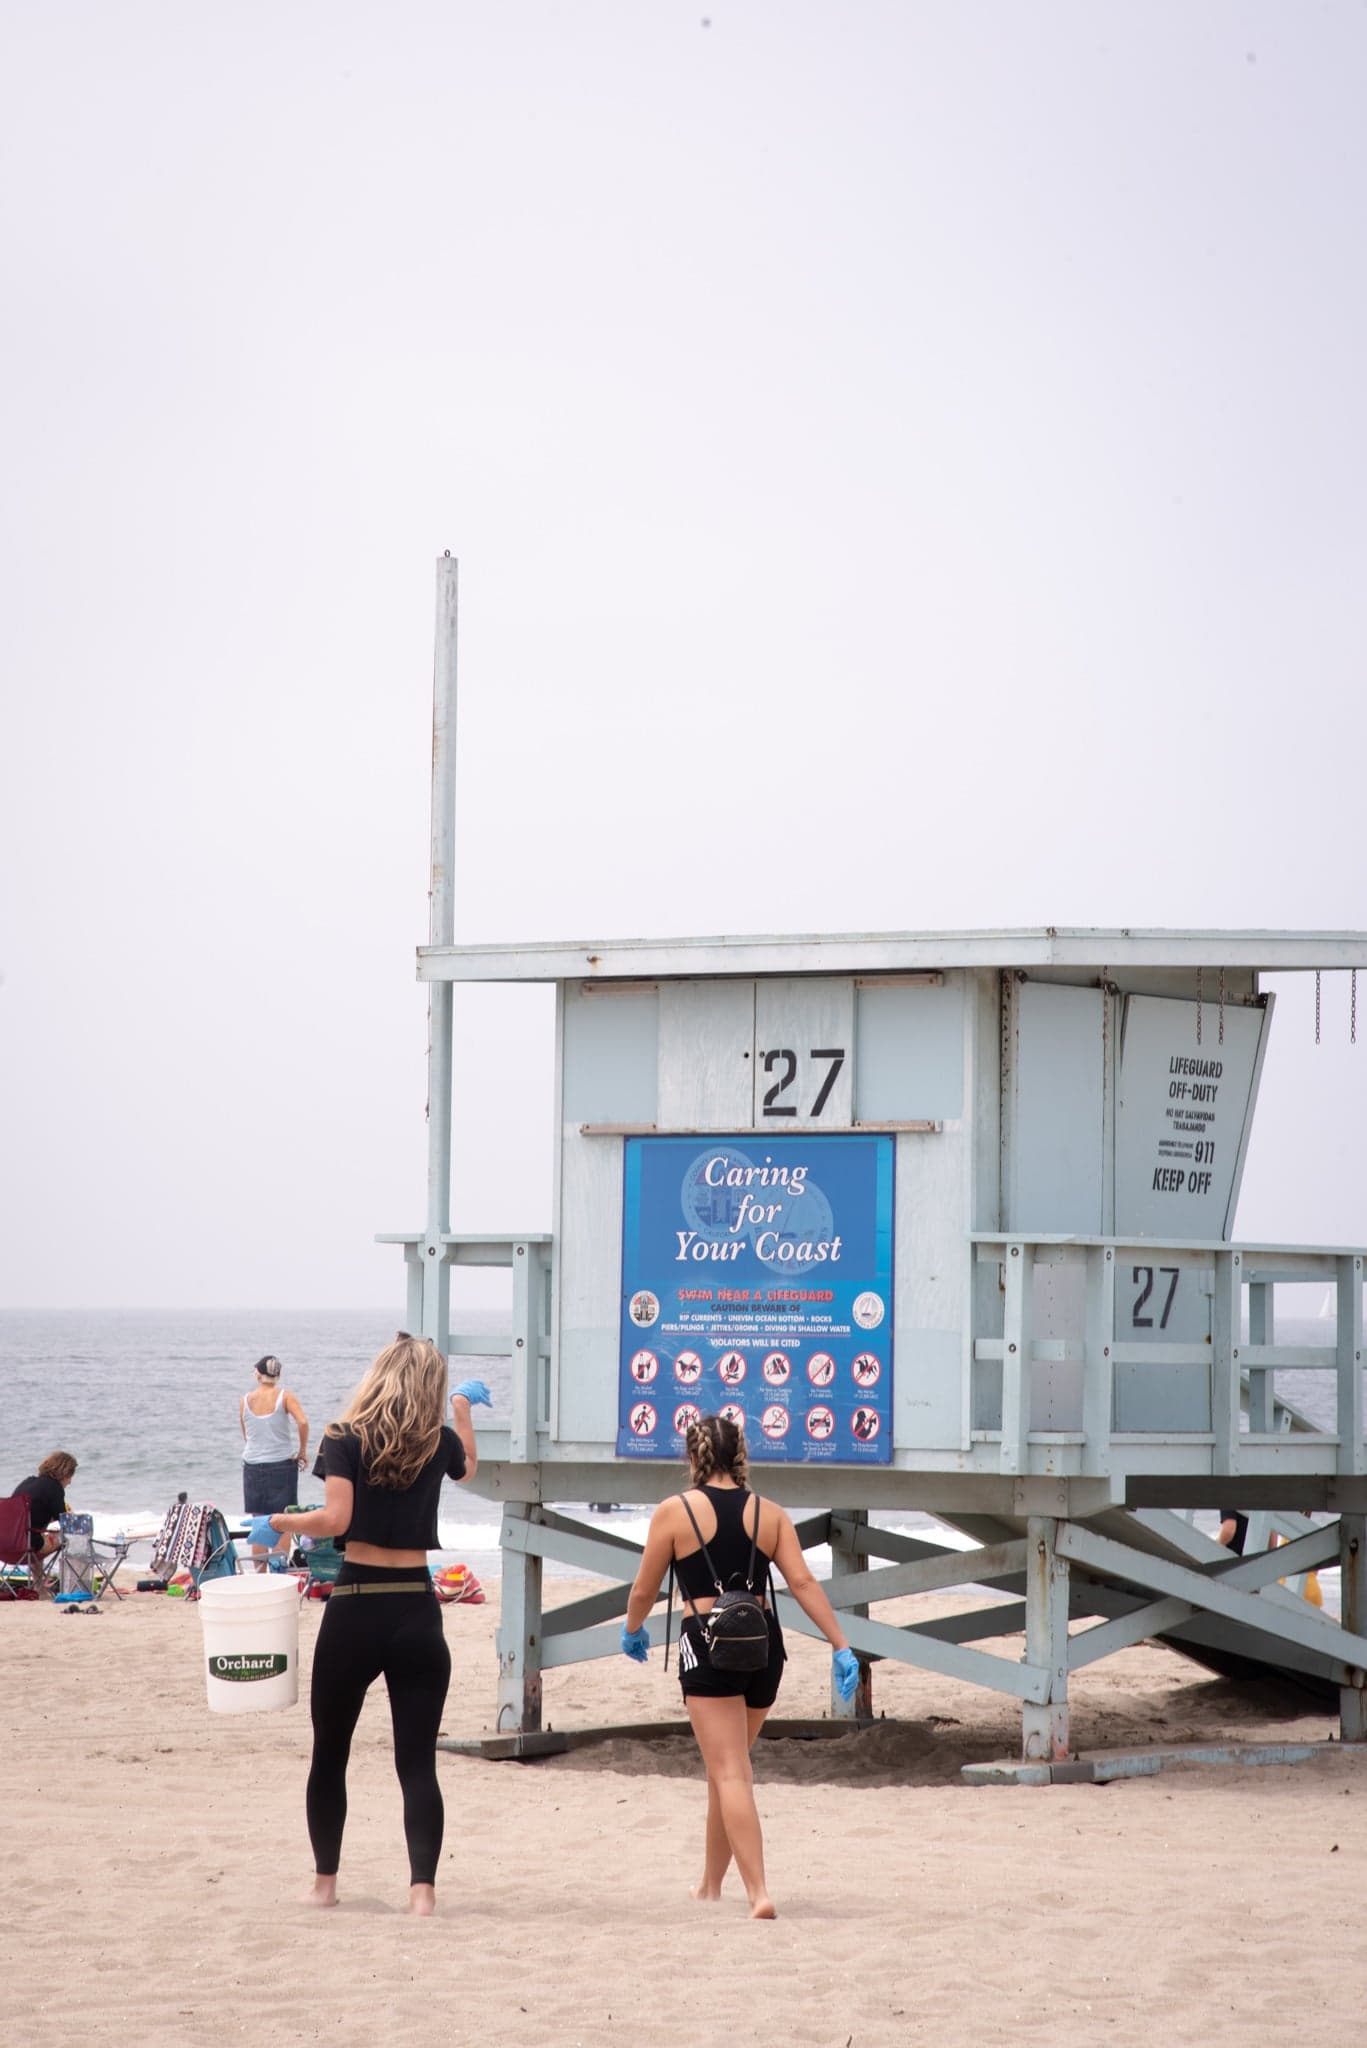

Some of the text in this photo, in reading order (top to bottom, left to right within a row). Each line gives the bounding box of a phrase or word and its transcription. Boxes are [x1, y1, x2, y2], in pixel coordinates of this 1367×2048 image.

[1169, 1056, 1223, 1078] LIFEGUARD
[763, 1048, 845, 1117] 27
[1169, 1081, 1218, 1103] OFF-DUTY
[1166, 1108, 1174, 1118] NO
[1185, 1110, 1215, 1122] SALVAVIDAS
[1195, 1141, 1215, 1164] 911
[705, 1157, 808, 1195] Caring
[1152, 1167, 1212, 1194] KEEP OFF
[729, 1194, 782, 1233] for
[675, 1231, 842, 1261] Your Coast
[678, 1289, 833, 1301] SWIM NEAR A LIFEGUARD
[1133, 1266, 1179, 1329] 27
[691, 1314, 722, 1322] CURRENTS
[778, 1315, 805, 1323] BOTTOM
[711, 1304, 748, 1312] CAUTION
[752, 1304, 786, 1312] BEWARE
[661, 1323, 704, 1331] PIERS/PILINGS
[798, 1325, 828, 1333] SHALLOW
[711, 1338, 801, 1347] VIOLATORS WILL BE CITED
[217, 1655, 275, 1671] Orchard
